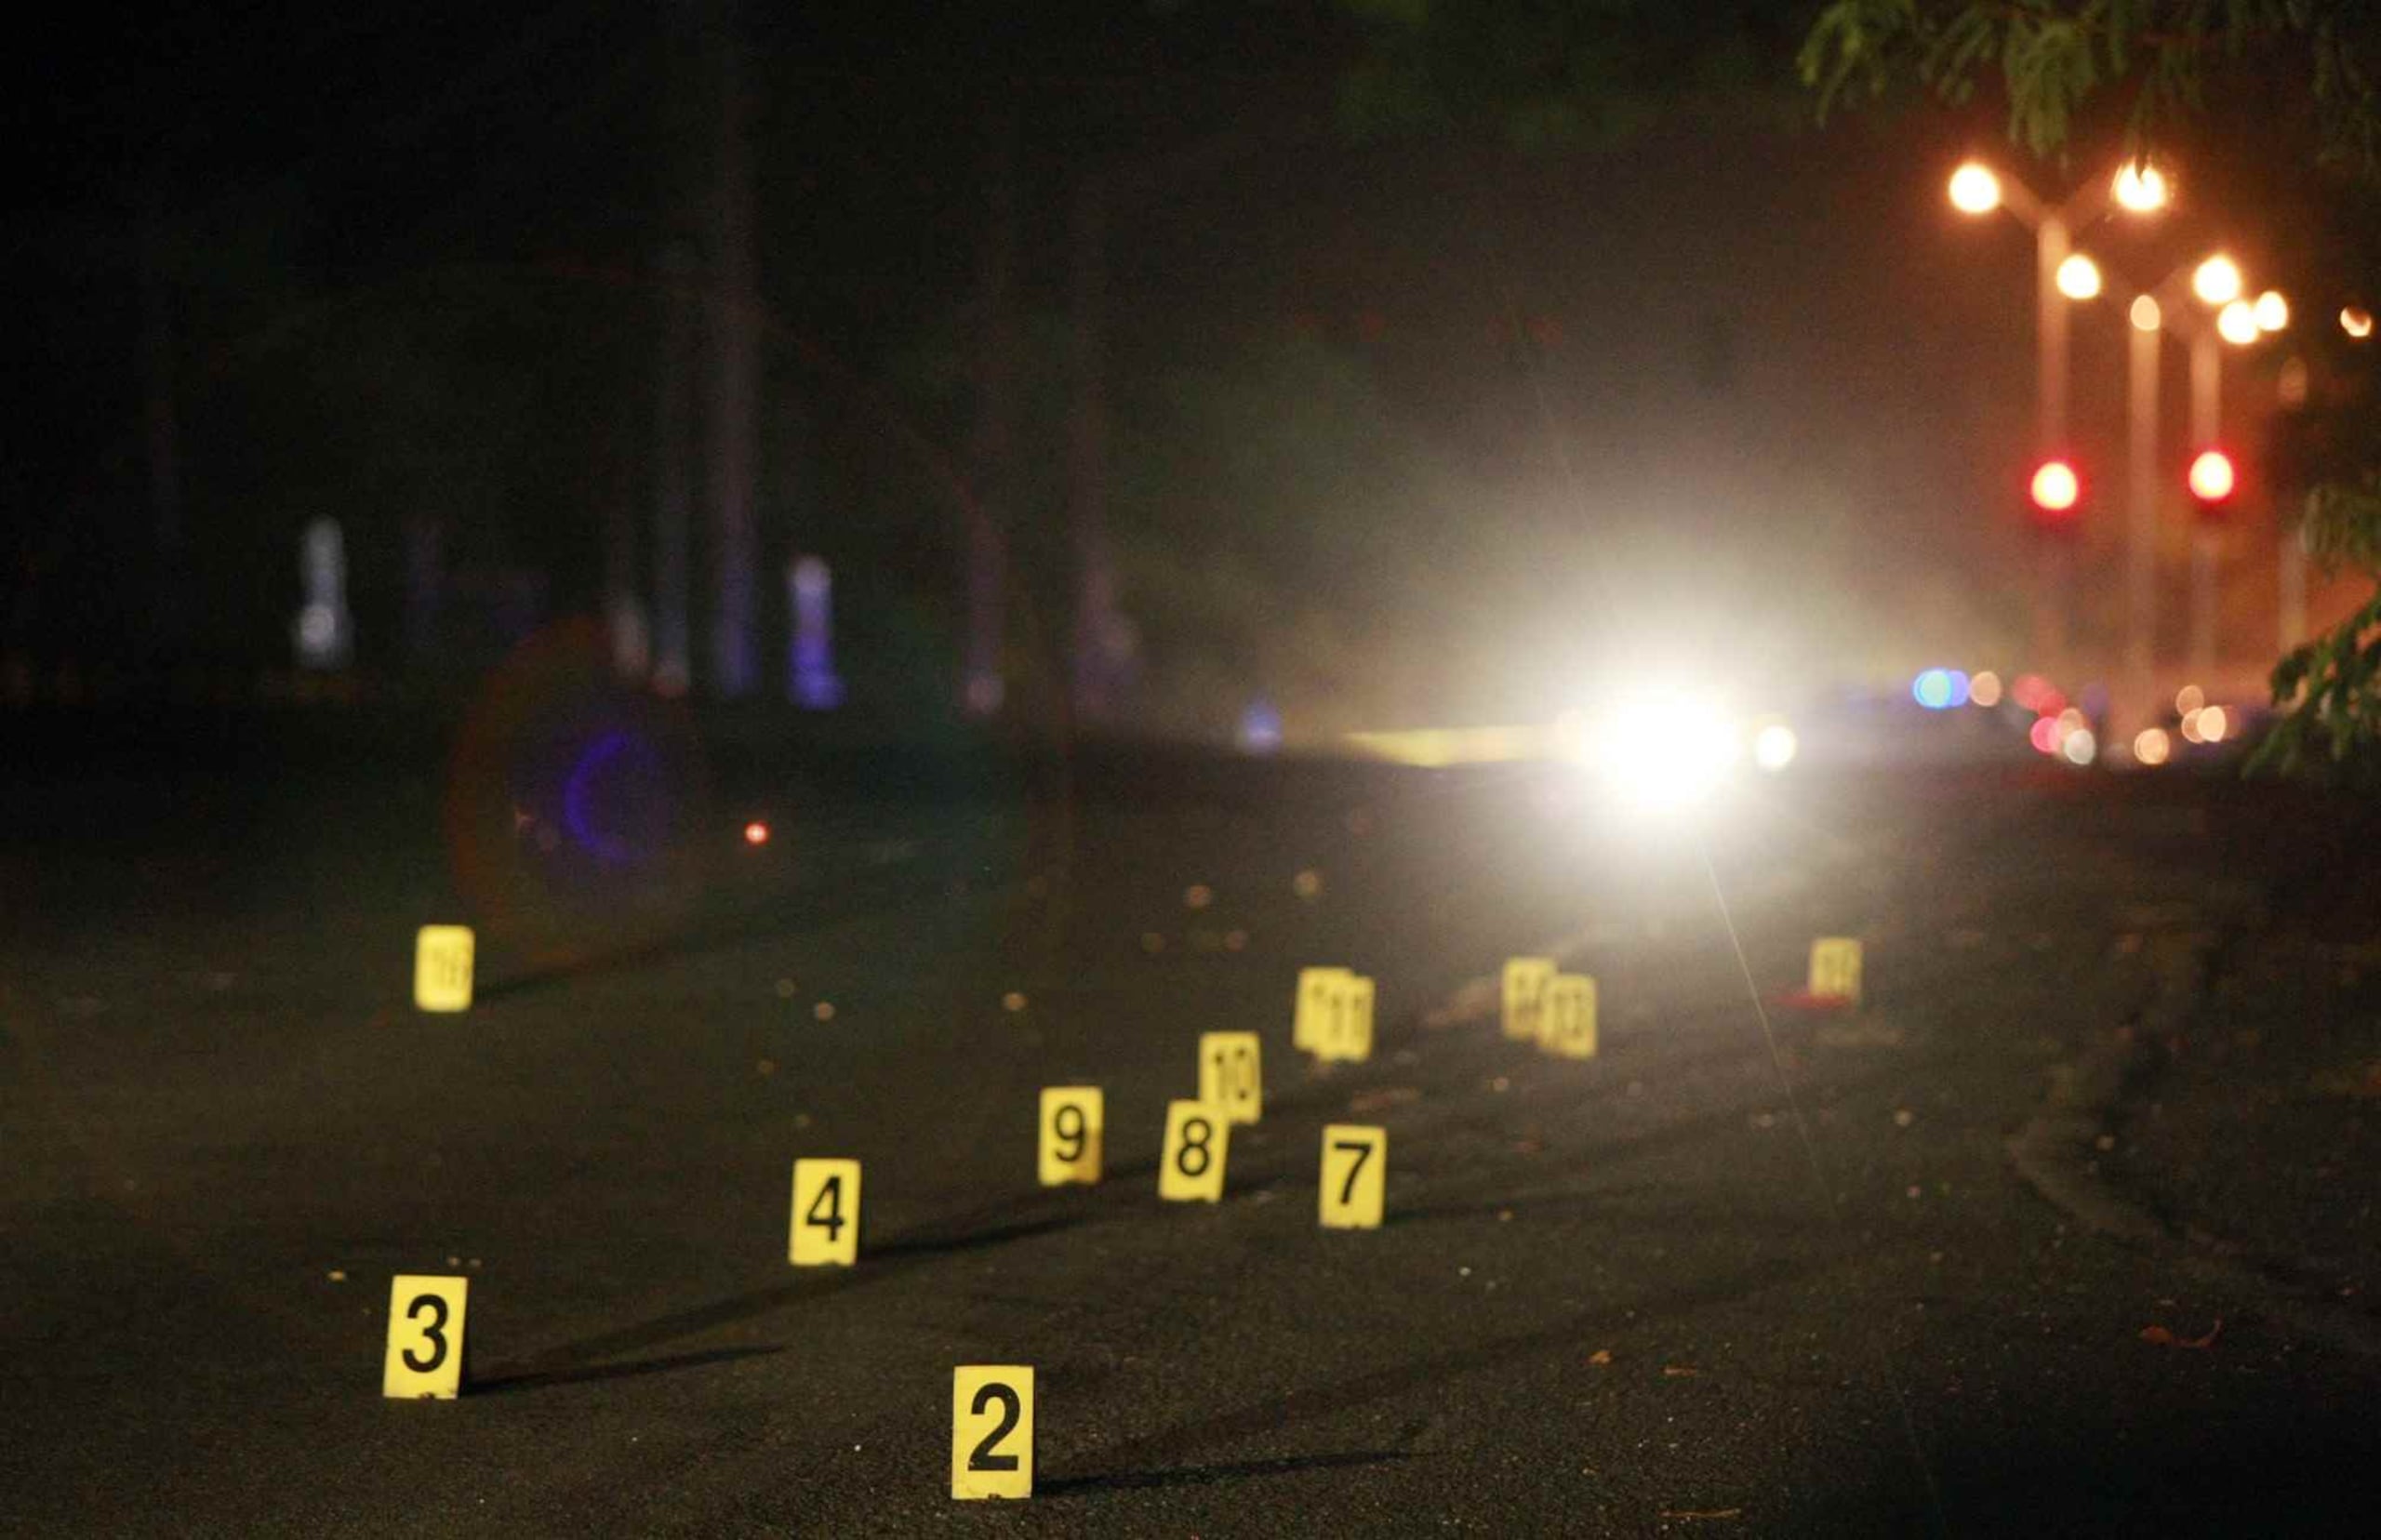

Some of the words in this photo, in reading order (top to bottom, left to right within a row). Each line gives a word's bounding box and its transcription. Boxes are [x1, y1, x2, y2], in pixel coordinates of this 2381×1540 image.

[1055, 1105, 1088, 1164] 9
[1177, 1118, 1212, 1177] 8
[1334, 1141, 1373, 1205] 7
[805, 1175, 845, 1242] 4
[402, 1294, 448, 1374] 3
[967, 1382, 1021, 1472] 2
